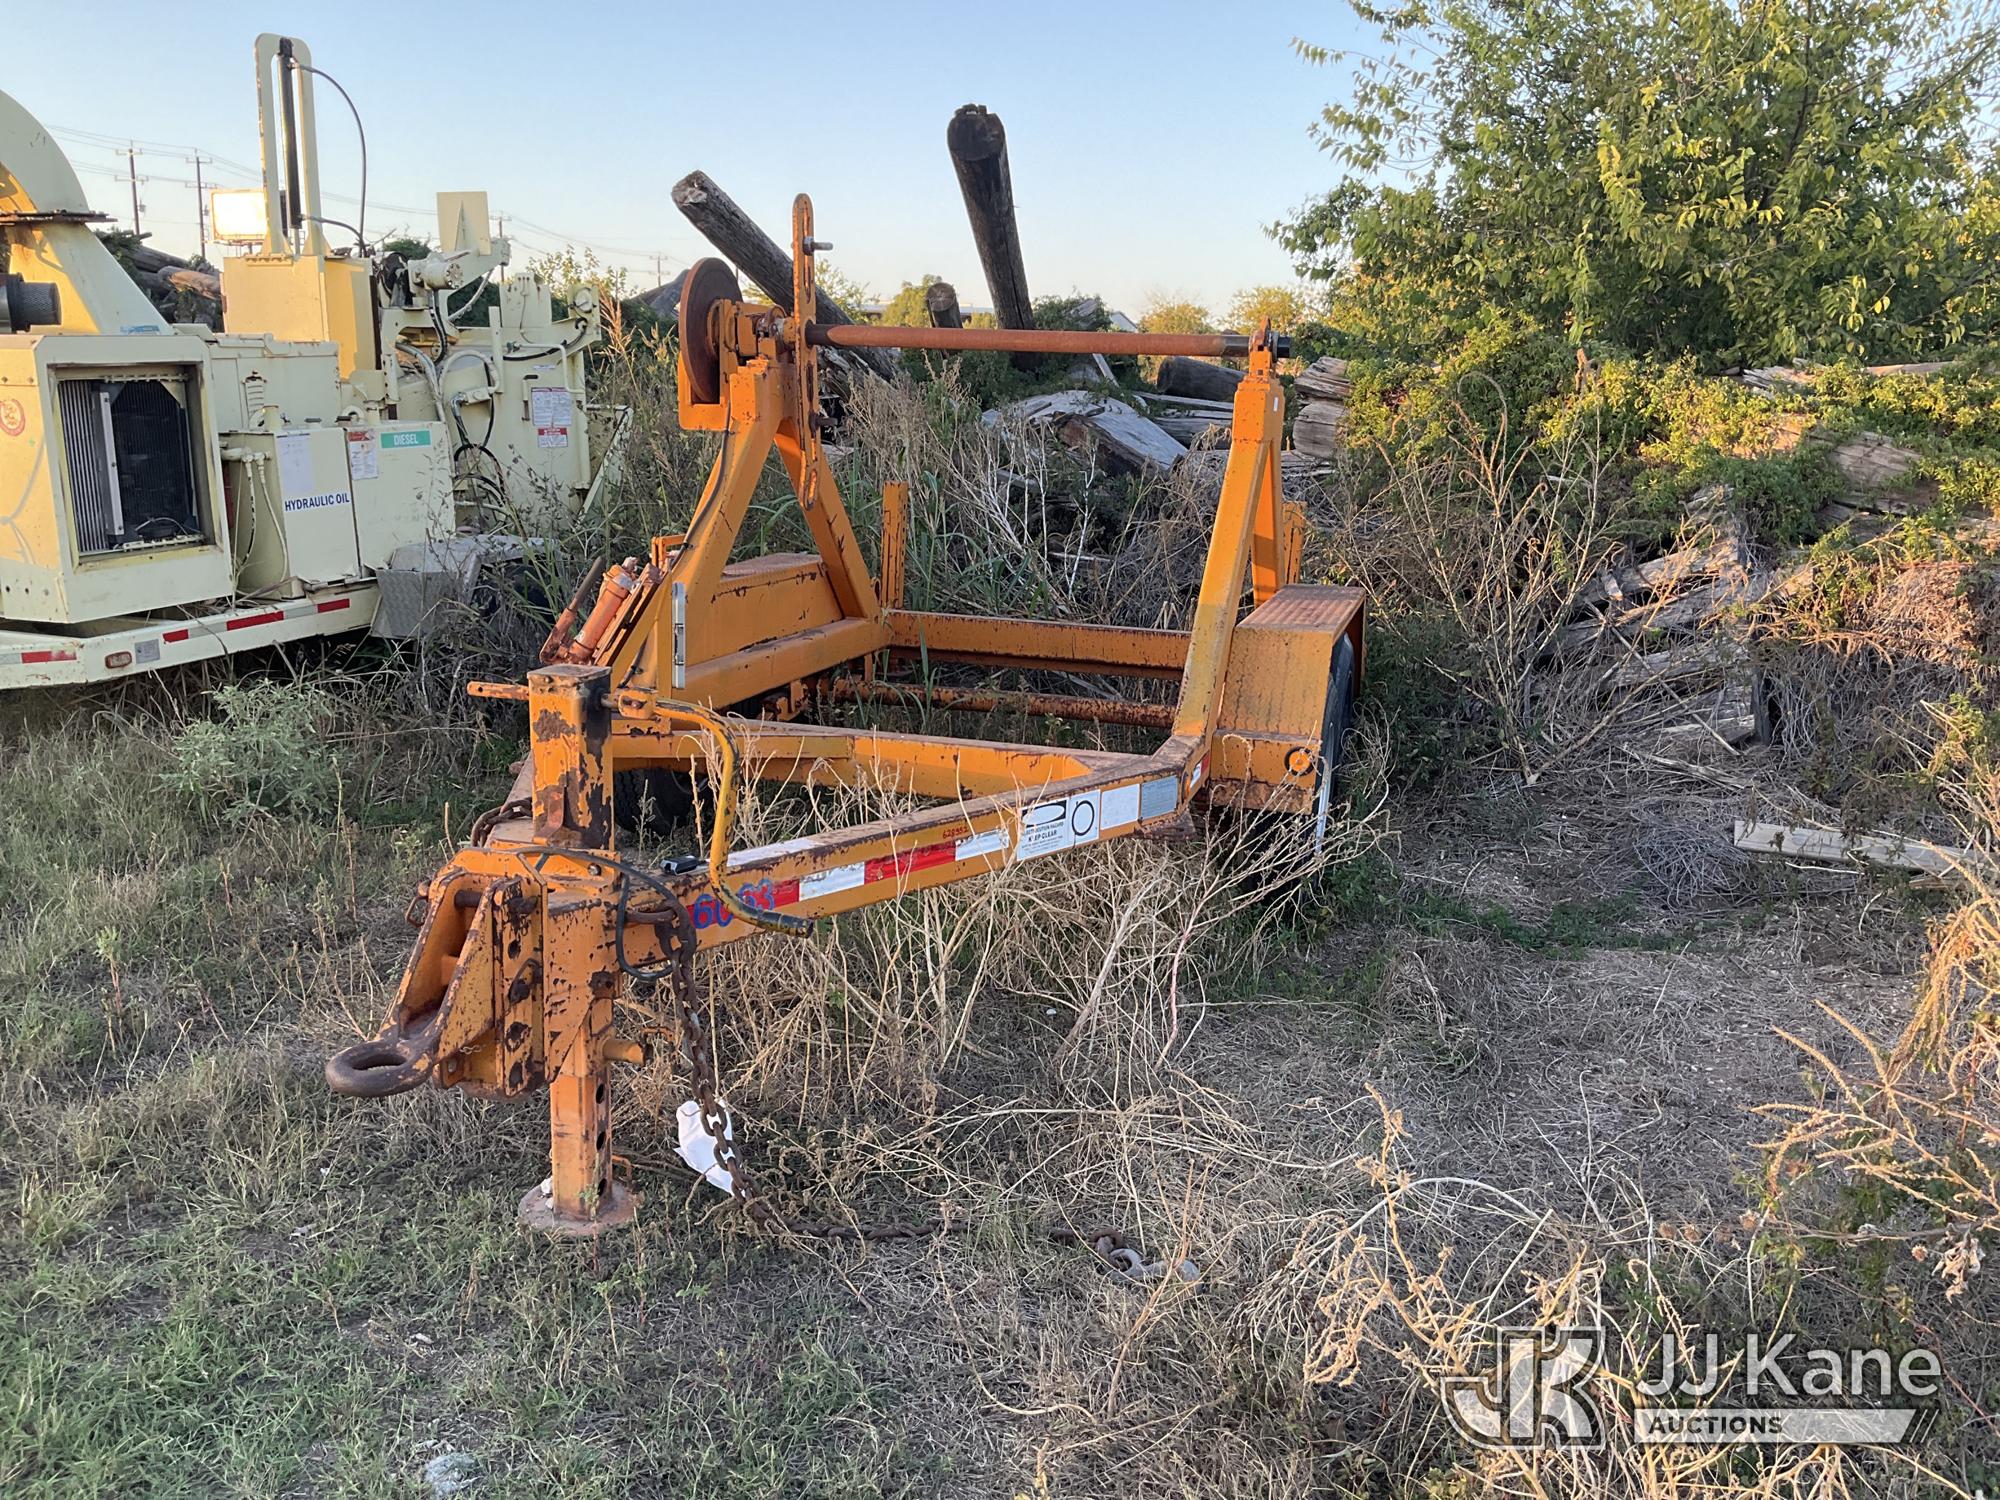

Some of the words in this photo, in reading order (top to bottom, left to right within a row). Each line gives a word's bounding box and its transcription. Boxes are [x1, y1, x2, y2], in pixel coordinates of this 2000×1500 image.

[393, 433, 419, 447] DIESEL
[284, 494, 335, 512] HYDRAULIC
[336, 492, 350, 504] OIL
[1042, 829, 1057, 839] CLEAR
